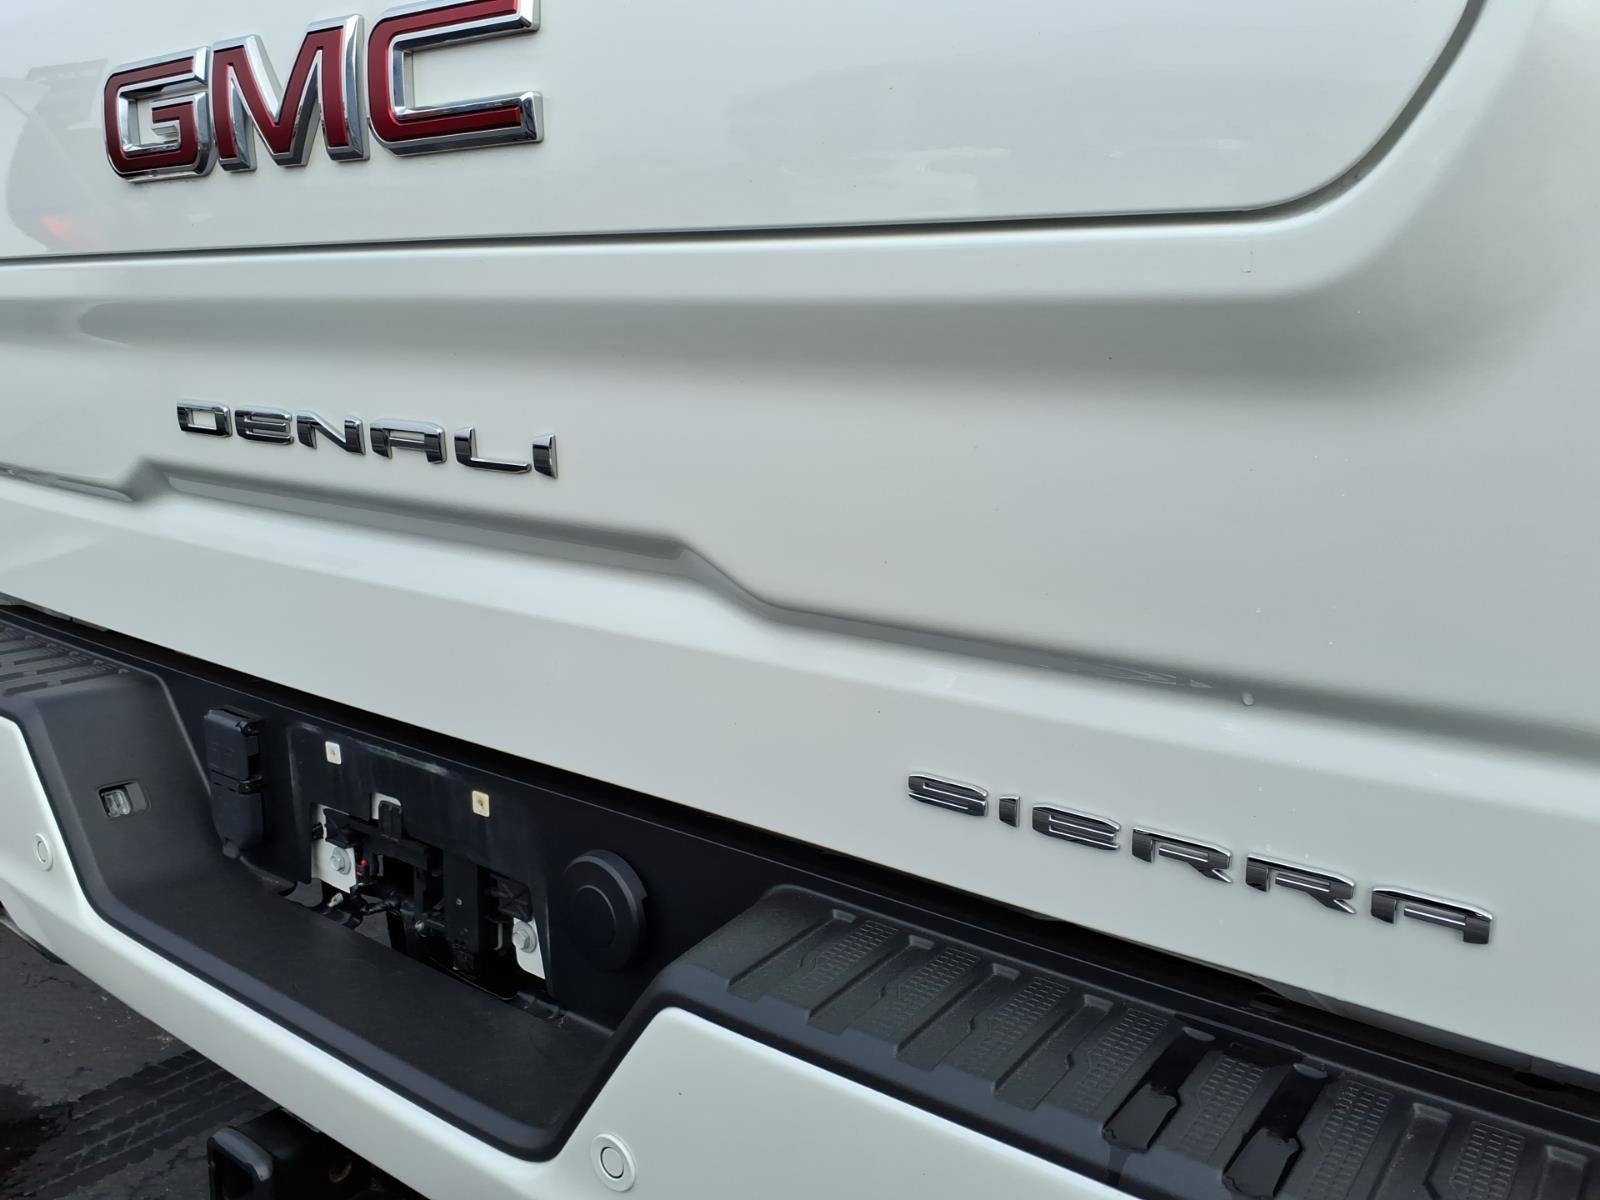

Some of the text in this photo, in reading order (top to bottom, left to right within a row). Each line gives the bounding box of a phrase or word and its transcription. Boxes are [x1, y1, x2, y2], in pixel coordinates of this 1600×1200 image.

[104, 0, 542, 182] GMC
[177, 399, 558, 479] DENALI
[907, 772, 1494, 945] SIERRA
